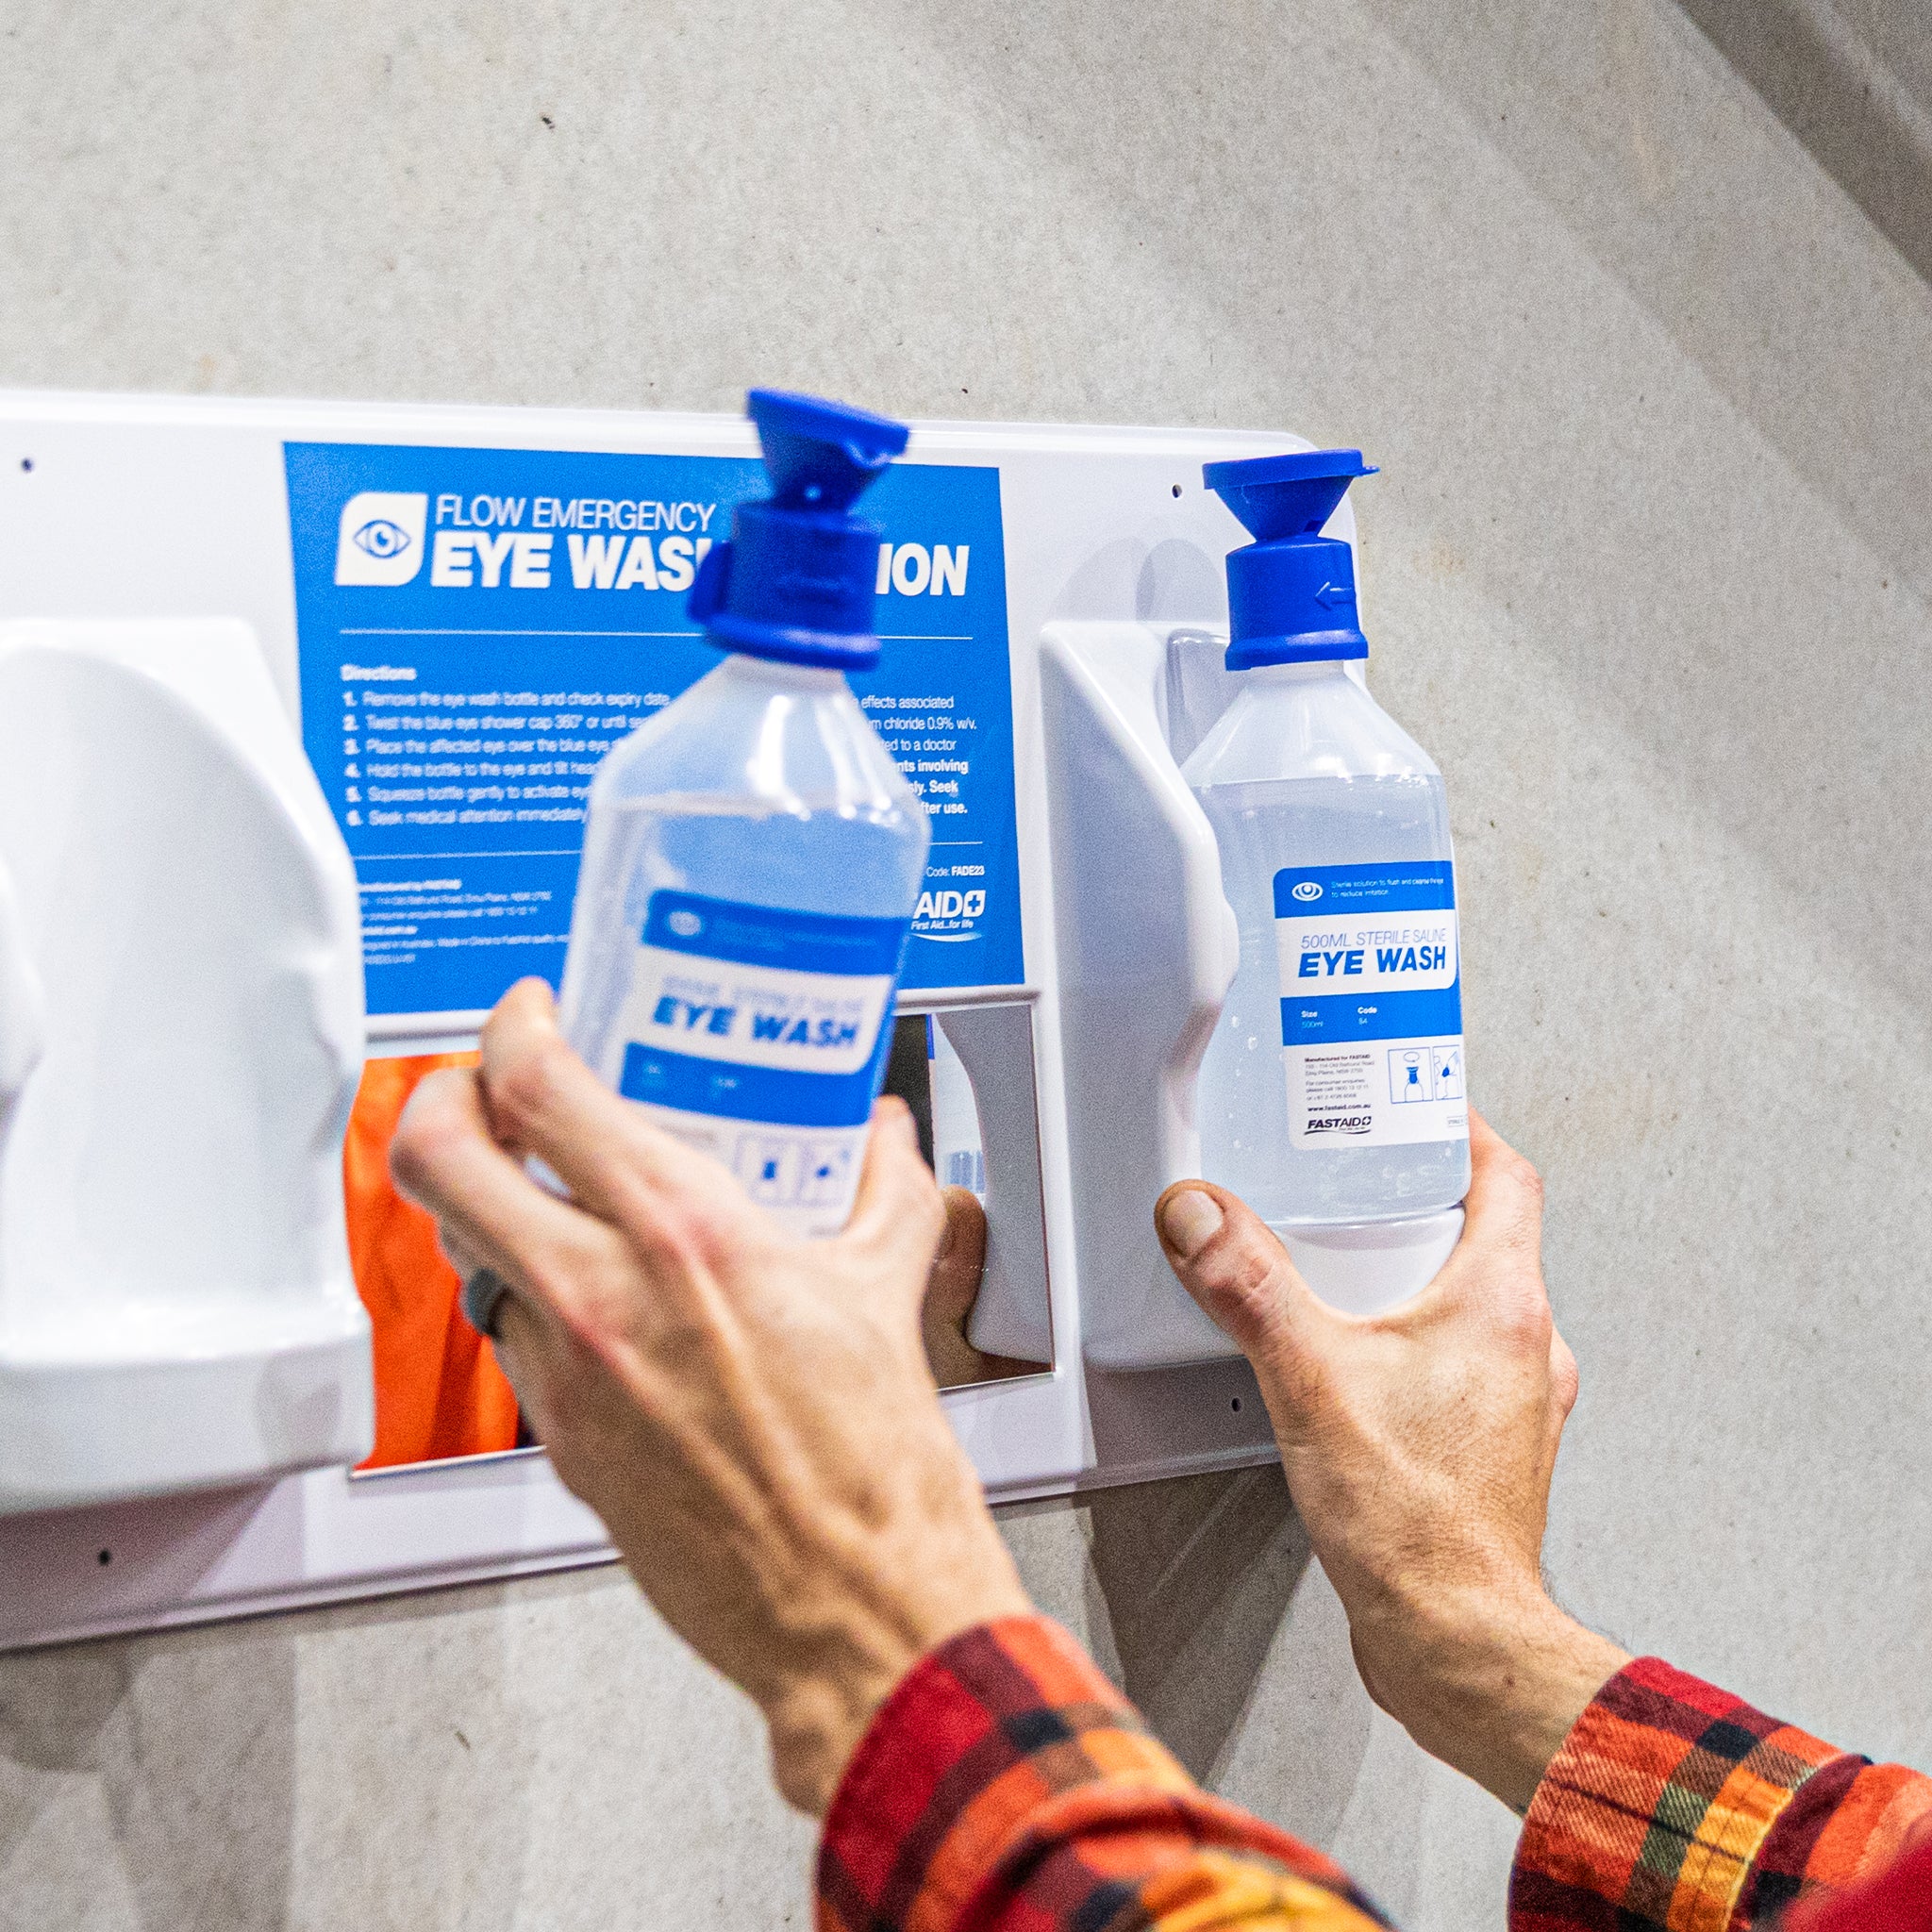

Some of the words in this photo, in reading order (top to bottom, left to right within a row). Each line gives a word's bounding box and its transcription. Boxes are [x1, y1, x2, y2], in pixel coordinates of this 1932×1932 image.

[436, 494, 525, 526] FLOW
[532, 497, 716, 532] EMERGENCY
[431, 530, 554, 589] EYE
[340, 663, 418, 682] Directions
[342, 691, 358, 708] 1.
[362, 691, 418, 707] Remove
[419, 691, 441, 707] the
[442, 693, 466, 709] eye
[467, 691, 501, 707] wash
[503, 691, 540, 707] bottle
[541, 691, 566, 707] and
[567, 691, 605, 707] check
[606, 691, 642, 708] expiry
[861, 694, 896, 708] effects
[898, 695, 955, 709] associated
[342, 713, 359, 731] 2.
[401, 715, 424, 731] the
[425, 715, 453, 731] blue
[454, 717, 479, 733] eye
[527, 717, 553, 732] cap
[586, 717, 600, 729] or
[601, 714, 627, 729] until
[883, 717, 925, 730] chloride
[926, 716, 954, 730] 0.9%
[957, 717, 977, 730] w/v.
[343, 738, 360, 756] 3.
[365, 738, 403, 755] Place
[404, 740, 427, 755] the
[429, 739, 481, 754] affected
[482, 741, 507, 756] eye
[508, 740, 535, 753] over
[537, 738, 558, 753] the
[558, 739, 586, 753] blue
[900, 739, 912, 752] to
[913, 741, 922, 752] a
[923, 739, 958, 752] doctor
[344, 762, 360, 778] 4.
[366, 762, 400, 778] Hold
[401, 762, 424, 778] the
[425, 762, 462, 777] bottle
[462, 762, 478, 776] to
[479, 761, 502, 776] the
[502, 763, 526, 778] eye
[526, 761, 553, 776] and
[917, 758, 970, 775] involving
[345, 786, 362, 803] 5.
[367, 786, 425, 803] Squeeze
[426, 786, 464, 801] bottle
[467, 785, 505, 803] gently
[506, 786, 521, 799] to
[522, 785, 570, 799] activate
[928, 779, 959, 793] Seek
[943, 802, 969, 814] use.
[346, 809, 363, 826] 6.
[368, 809, 404, 826] Seek
[405, 809, 457, 825] medical
[458, 808, 514, 824] attention
[925, 866, 950, 877] Code:
[951, 865, 986, 876] FADE23
[910, 920, 930, 930] First
[961, 918, 974, 929] life
[1300, 932, 1352, 950] 500ML
[1355, 929, 1410, 947] STERILE
[1412, 927, 1446, 943] SALINE
[1298, 949, 1365, 978] EYE
[1376, 945, 1446, 974] WASH
[1357, 1006, 1378, 1014] Code
[652, 995, 736, 1037] EYE
[752, 1014, 861, 1047] WASH
[1301, 1021, 1324, 1029] 500ml
[1307, 1103, 1372, 1112] www.fastaid.com.au
[1307, 1116, 1361, 1129] FASTAID
